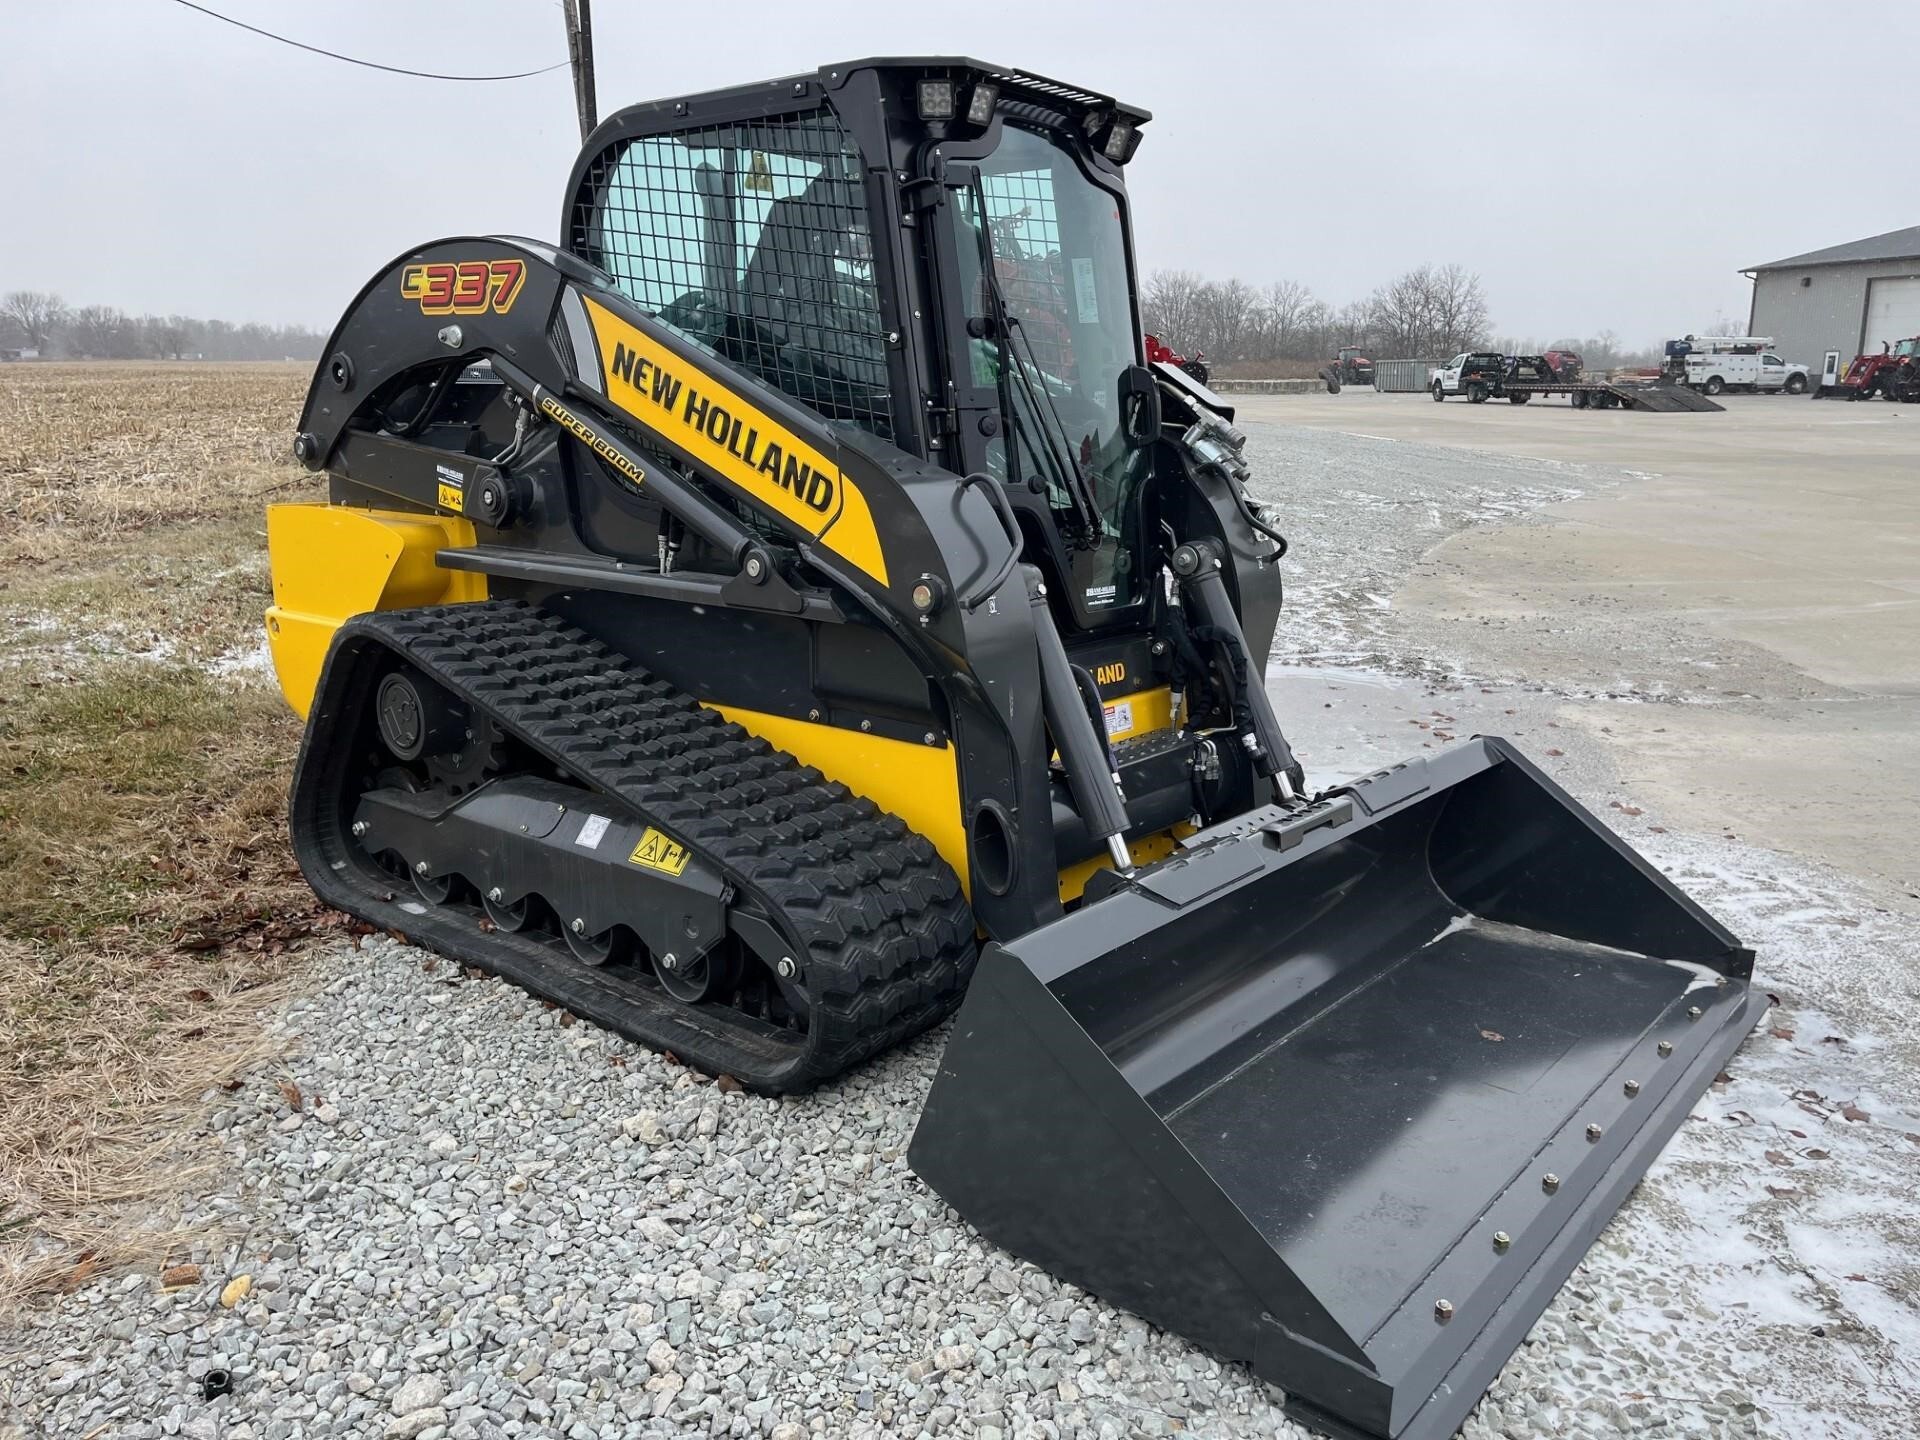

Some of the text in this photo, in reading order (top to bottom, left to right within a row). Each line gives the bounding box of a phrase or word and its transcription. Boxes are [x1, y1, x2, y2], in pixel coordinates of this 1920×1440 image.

[401, 260, 526, 314] C337
[542, 398, 644, 483] SUPER BOOM
[611, 341, 834, 513] NEW HOLLAND
[1092, 663, 1125, 685] AND
